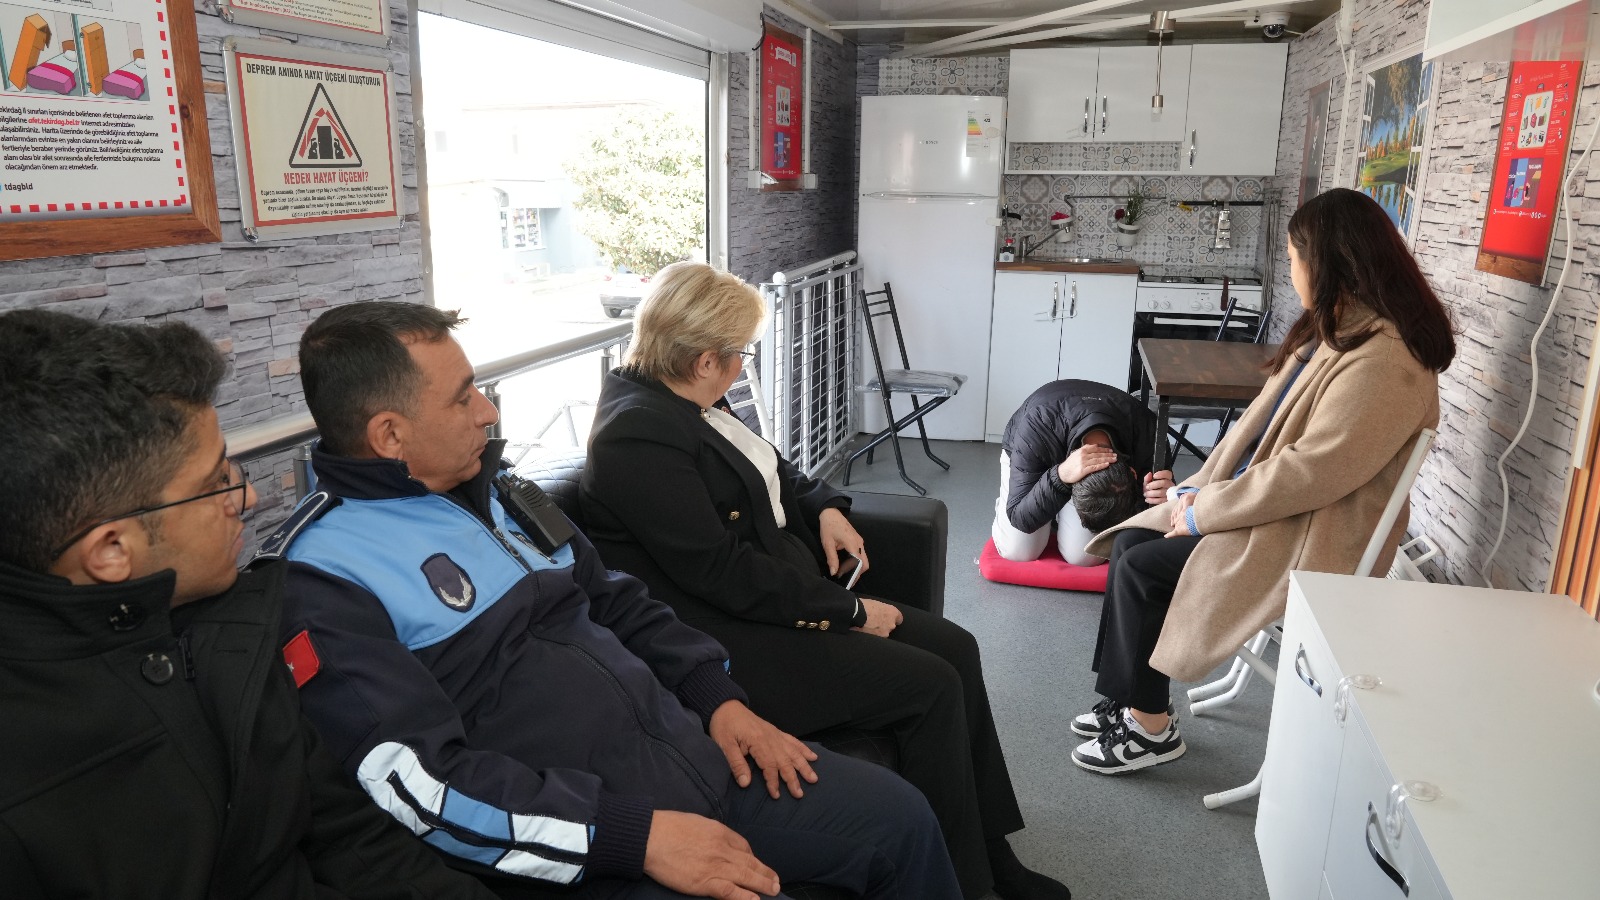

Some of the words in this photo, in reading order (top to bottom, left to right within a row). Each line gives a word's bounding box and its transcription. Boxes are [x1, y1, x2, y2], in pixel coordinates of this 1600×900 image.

[246, 63, 277, 76] DEPREM
[278, 66, 303, 78] ANINDA
[304, 69, 323, 81] HAYAT
[325, 69, 347, 84] ÜÇGENİ
[348, 73, 381, 87] OLUŞTURUN
[0, 105, 22, 115] ekirdağ
[28, 117, 80, 126] afet.tekirdag.bel.tr
[41, 126, 59, 134] Harita
[31, 144, 54, 152] beraber
[54, 145, 75, 154] yerinde
[33, 153, 41, 161] bir
[5, 163, 41, 172] olacağından
[41, 163, 59, 171] önem
[283, 172, 311, 185] NEDEN
[312, 171, 337, 184] HAYAT
[338, 168, 369, 186] ÜÇGENİ?
[4, 183, 33, 191] tdagbld
